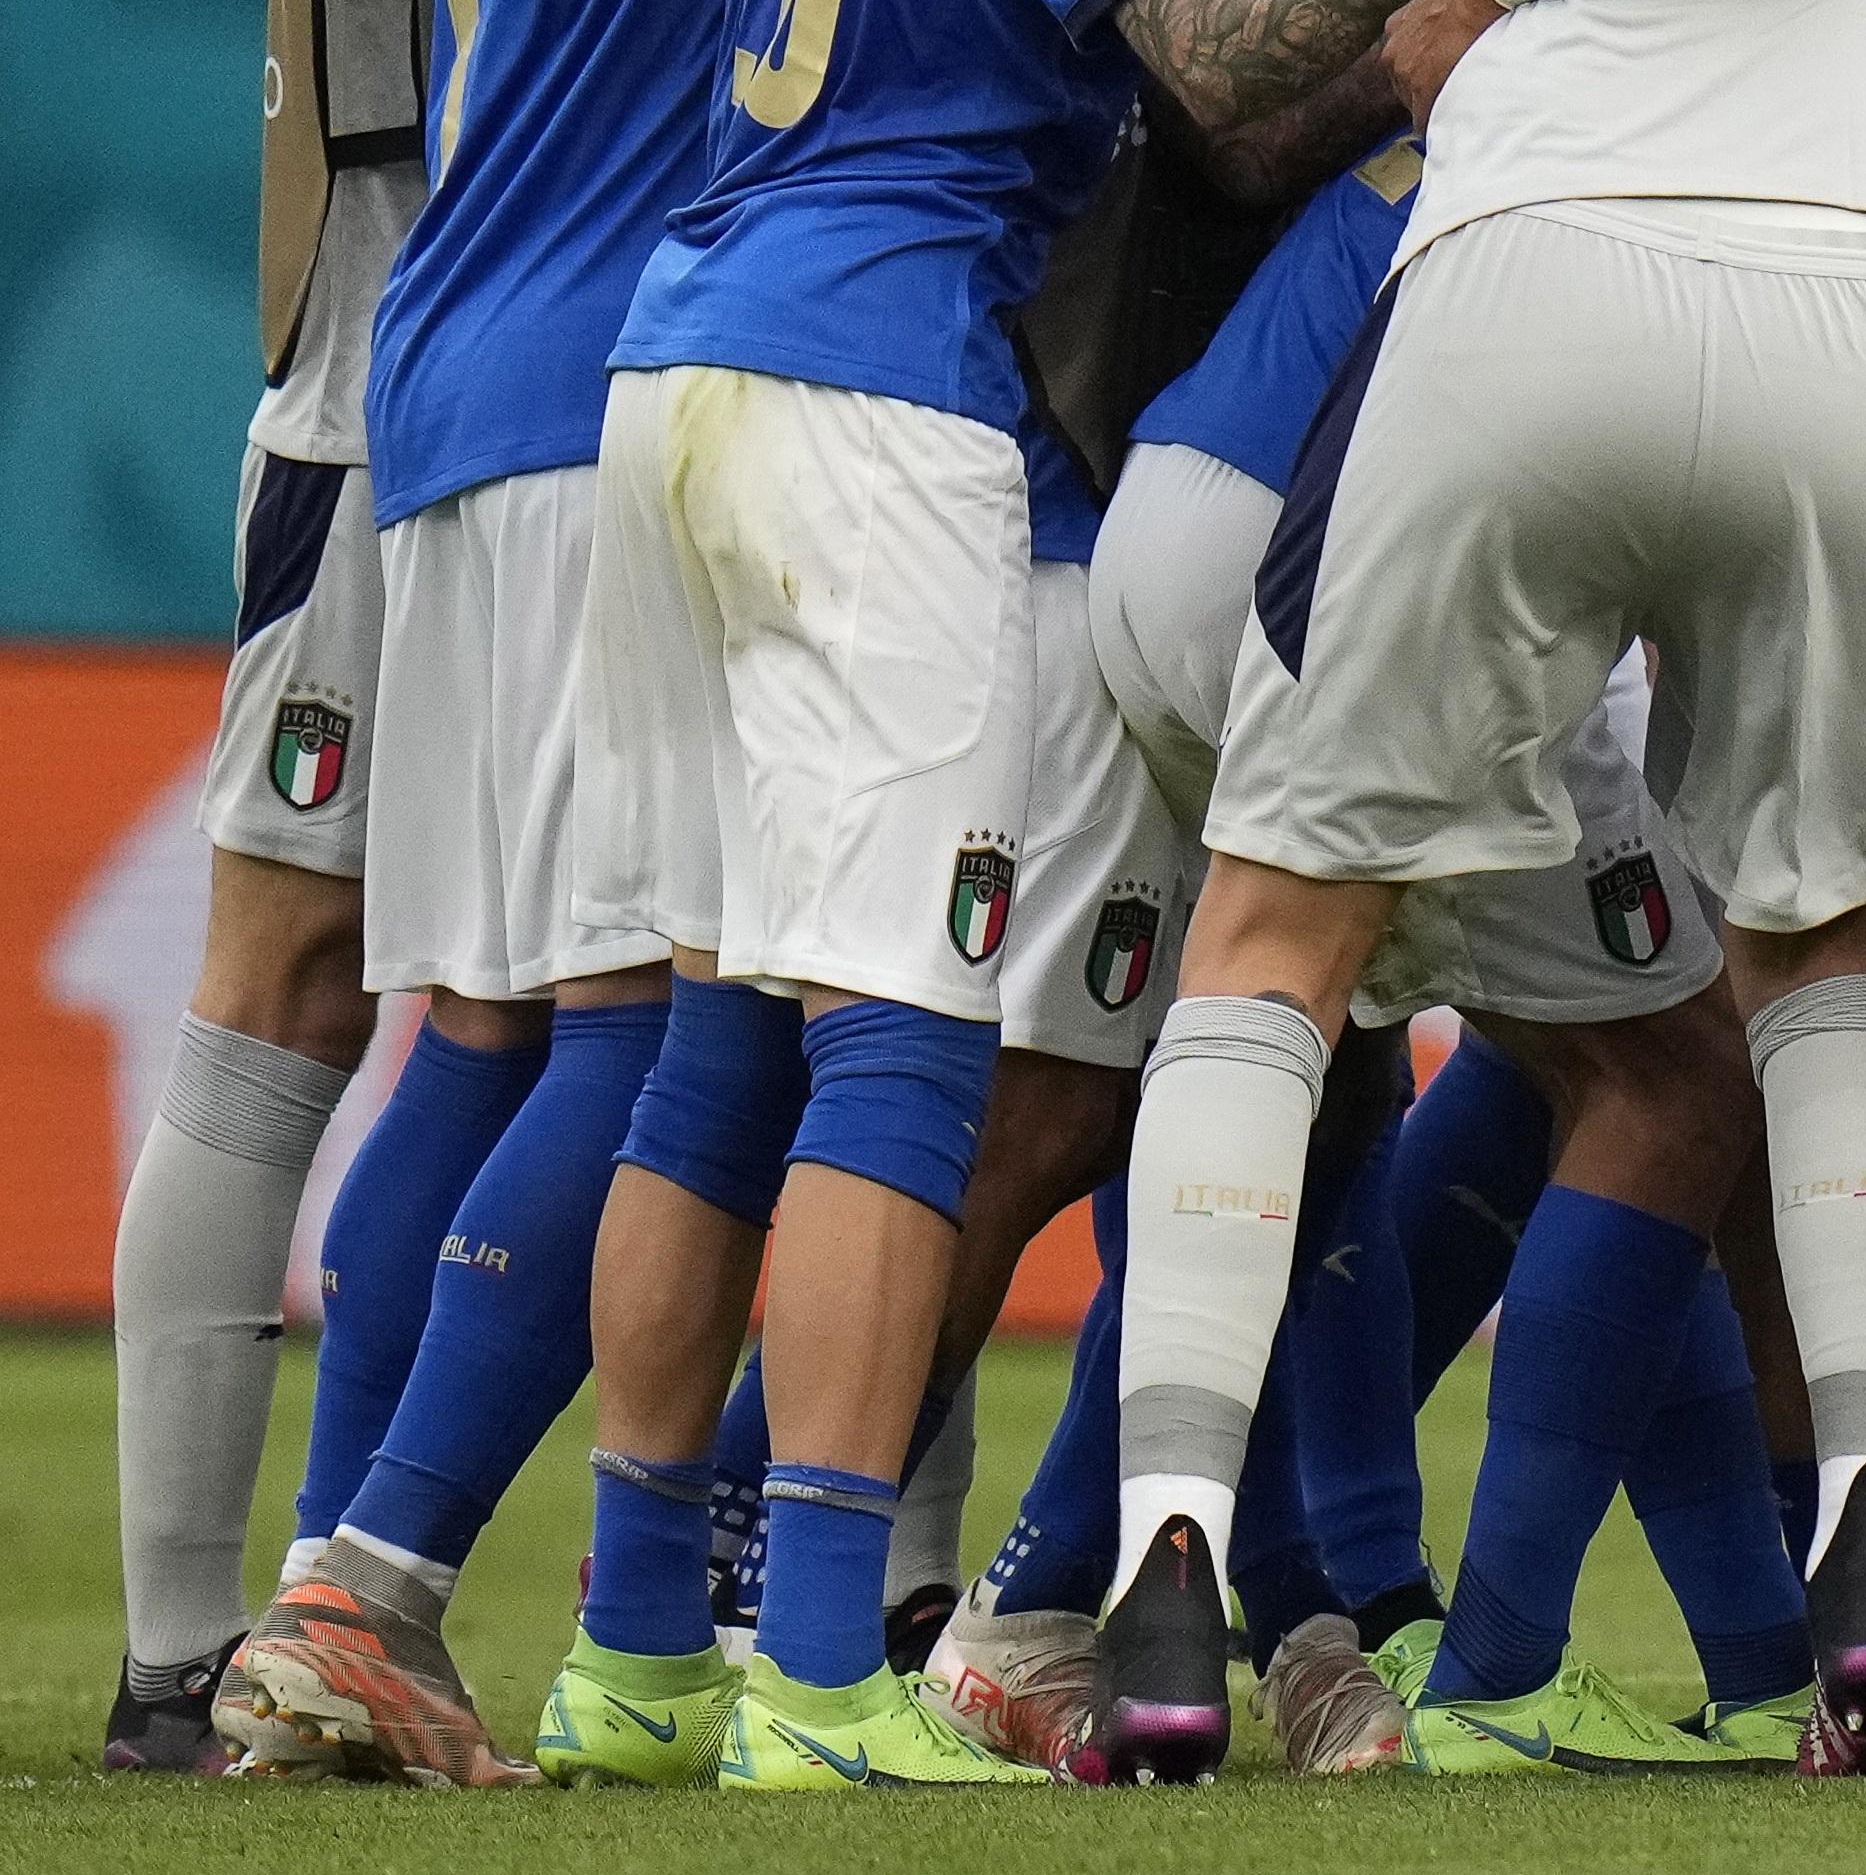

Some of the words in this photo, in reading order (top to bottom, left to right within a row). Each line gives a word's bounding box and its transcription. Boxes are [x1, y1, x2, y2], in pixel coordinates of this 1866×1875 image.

[282, 708, 346, 735] ITALIA
[962, 856, 1012, 879] ITALIA
[1173, 1184, 1289, 1215] ITALIA
[440, 1234, 510, 1273] ALIA
